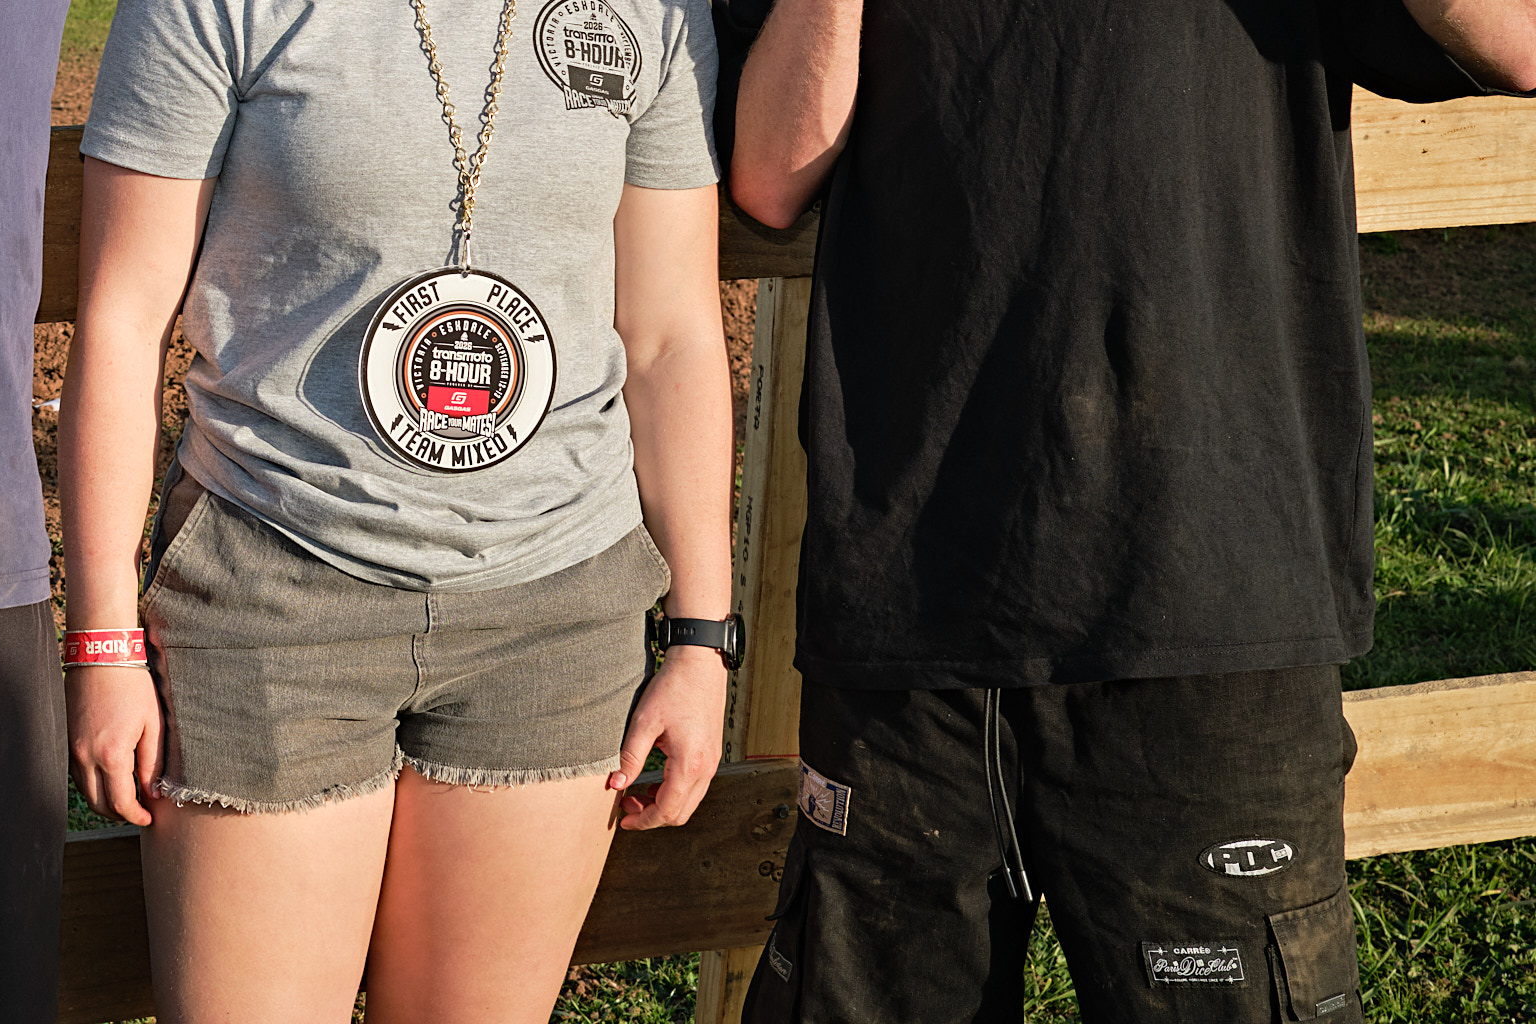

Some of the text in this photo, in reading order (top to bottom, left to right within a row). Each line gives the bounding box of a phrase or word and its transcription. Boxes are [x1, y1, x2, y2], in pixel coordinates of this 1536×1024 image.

[565, 0, 614, 22] ESKDALE
[563, 26, 617, 45] transmo
[584, 21, 603, 30] 2026
[547, 18, 561, 67] VICTORIA
[564, 85, 596, 110] RACE
[393, 281, 538, 333] FIRST PLACE
[439, 320, 492, 340] ESKDALE
[432, 346, 494, 363] transmoto
[454, 341, 472, 349] 2026
[414, 338, 432, 390] VICTORIA
[430, 360, 491, 385] 8-HOUR
[495, 343, 509, 379] SEPTEMBER
[753, 364, 764, 430] PORTA
[419, 407, 449, 432] RACE
[462, 411, 497, 438] MATES!
[398, 424, 508, 466] TEAM MIXED
[85, 639, 128, 655] RIDER
[1153, 956, 1234, 976] Paris Dice Club
